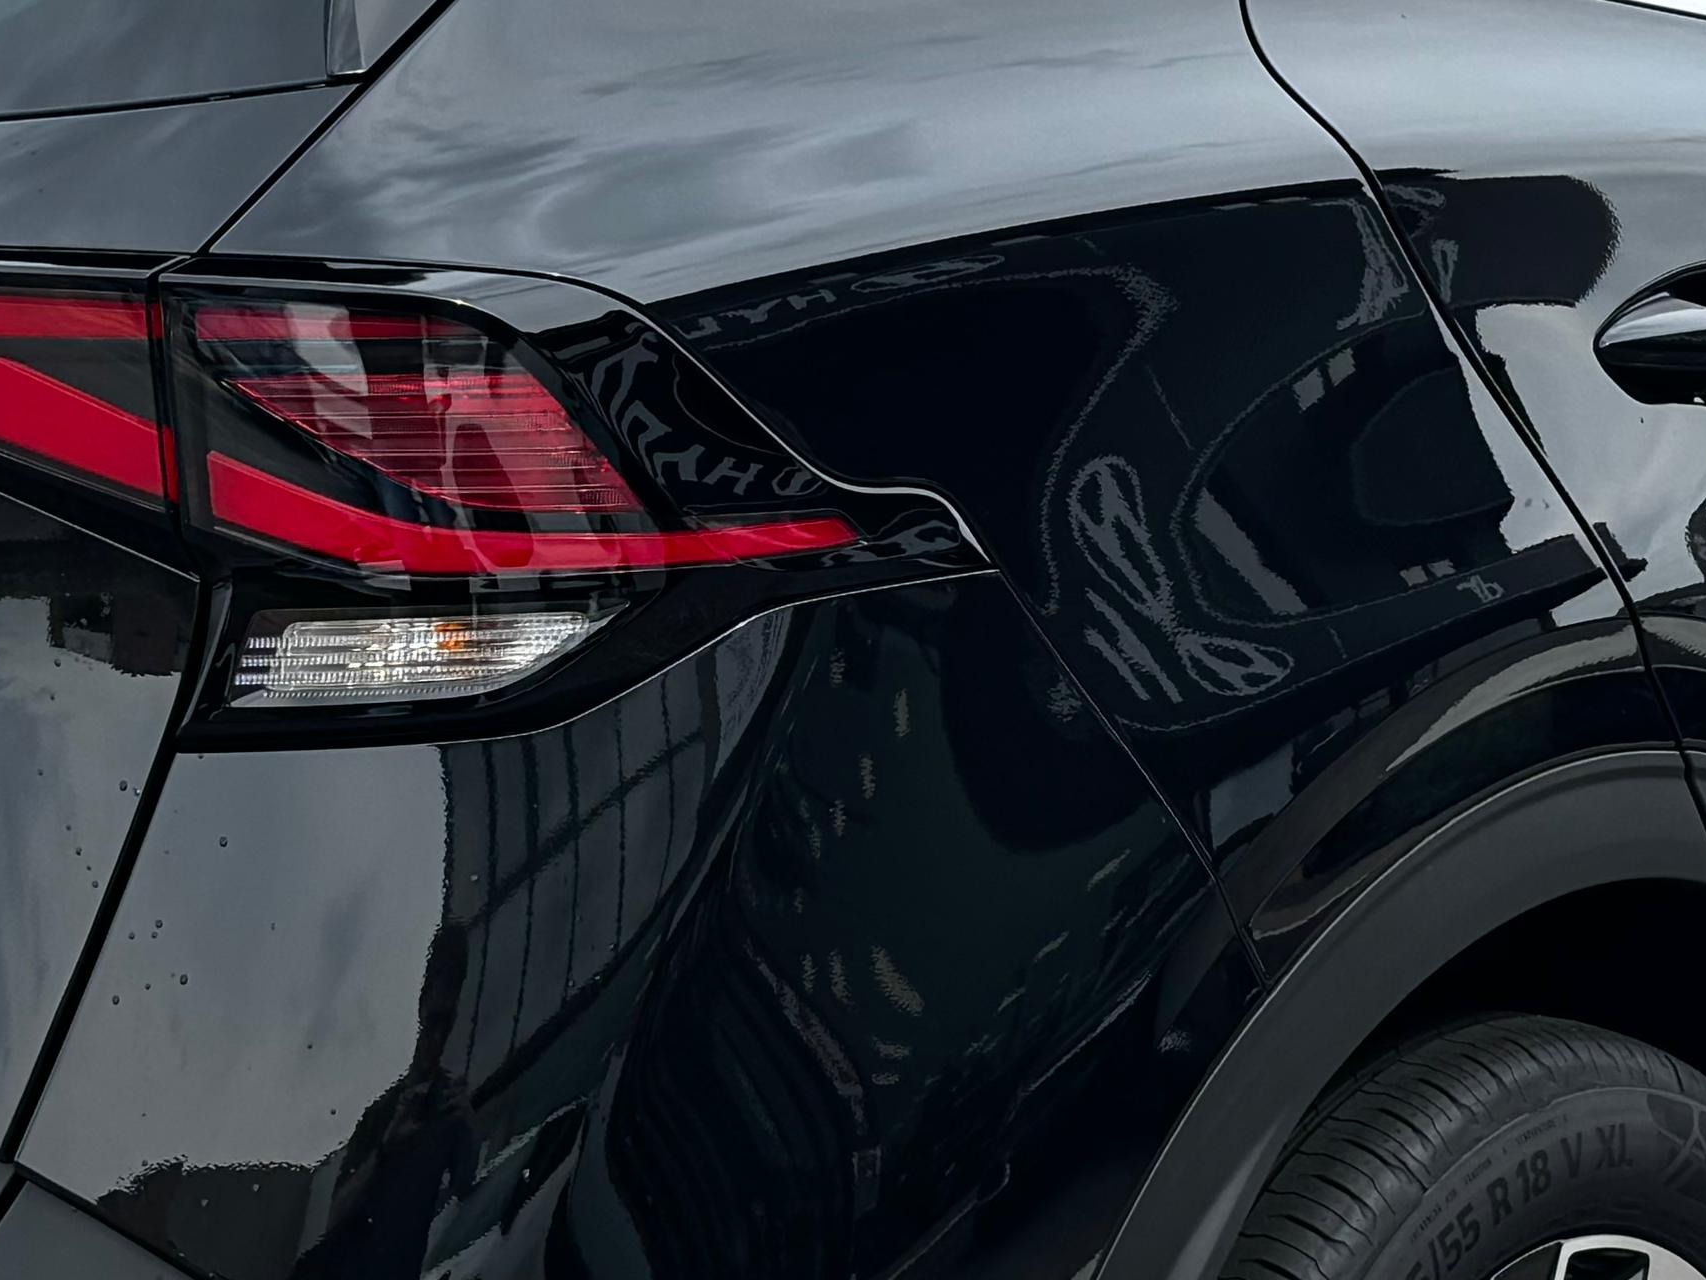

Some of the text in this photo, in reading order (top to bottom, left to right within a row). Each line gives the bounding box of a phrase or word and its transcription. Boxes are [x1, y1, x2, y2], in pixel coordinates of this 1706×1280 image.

[1486, 1176, 1513, 1226] R
[1515, 1149, 1552, 1204] 18
[1559, 1131, 1583, 1180] V
[1595, 1122, 1635, 1171] XL
